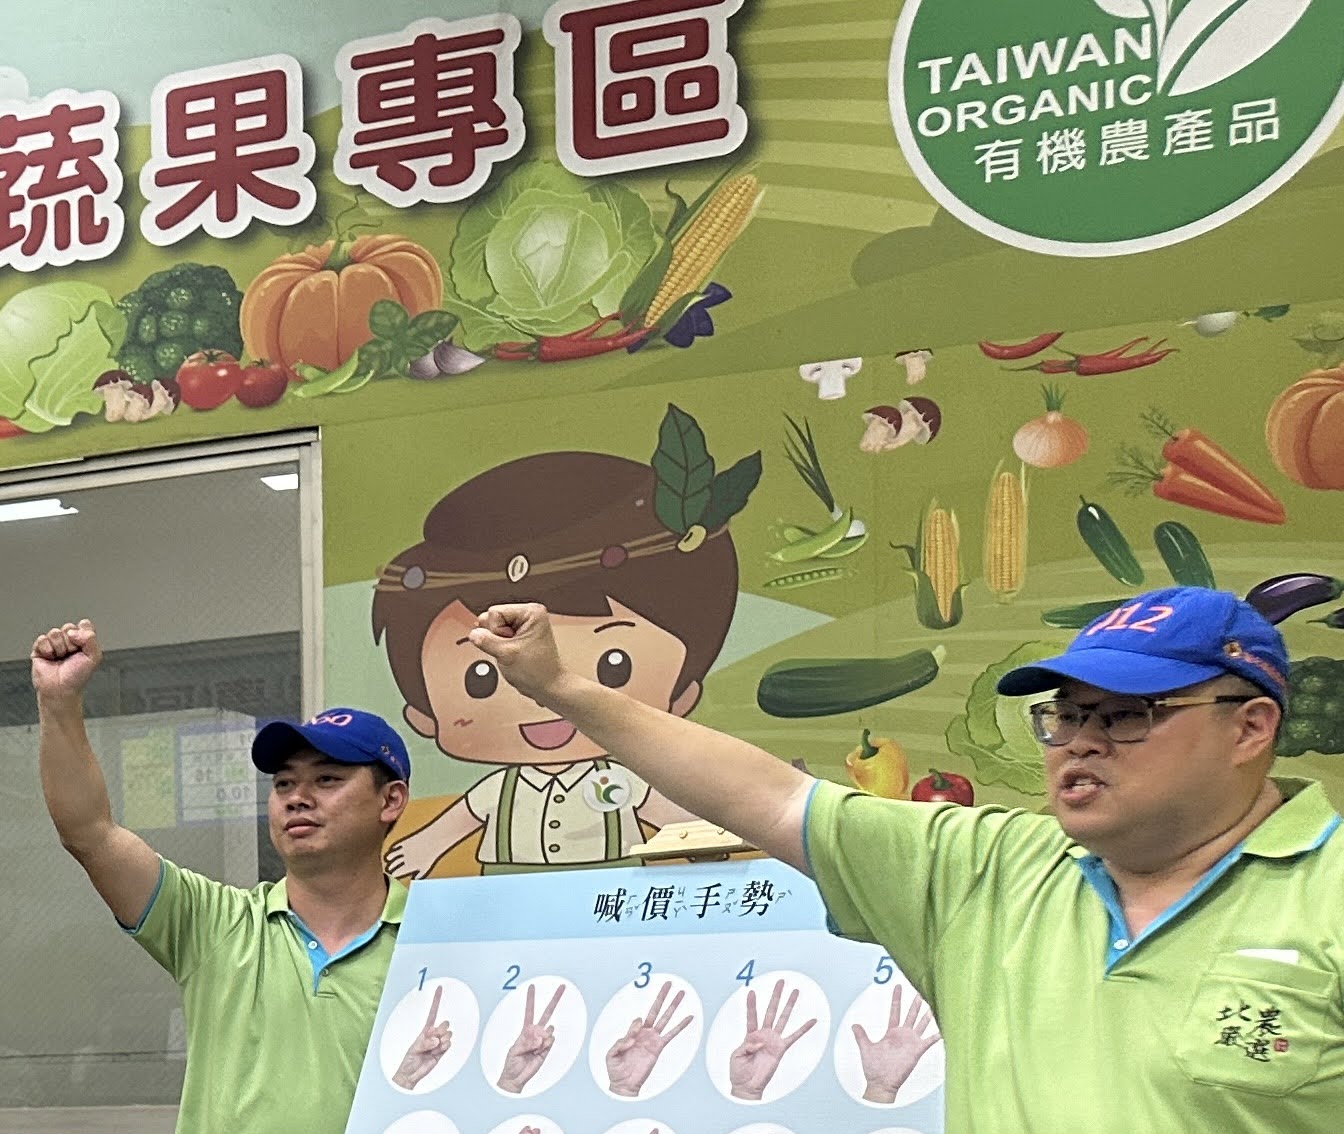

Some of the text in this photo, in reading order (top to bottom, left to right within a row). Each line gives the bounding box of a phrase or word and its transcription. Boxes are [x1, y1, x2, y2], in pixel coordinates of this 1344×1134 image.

[917, 22, 1153, 95] TAIWAN
[916, 73, 1153, 138] ORGANIC
[973, 97, 1281, 184] 有機農產品
[593, 880, 775, 923] 喊價手勢
[416, 955, 896, 992] 1 2 3 4 5
